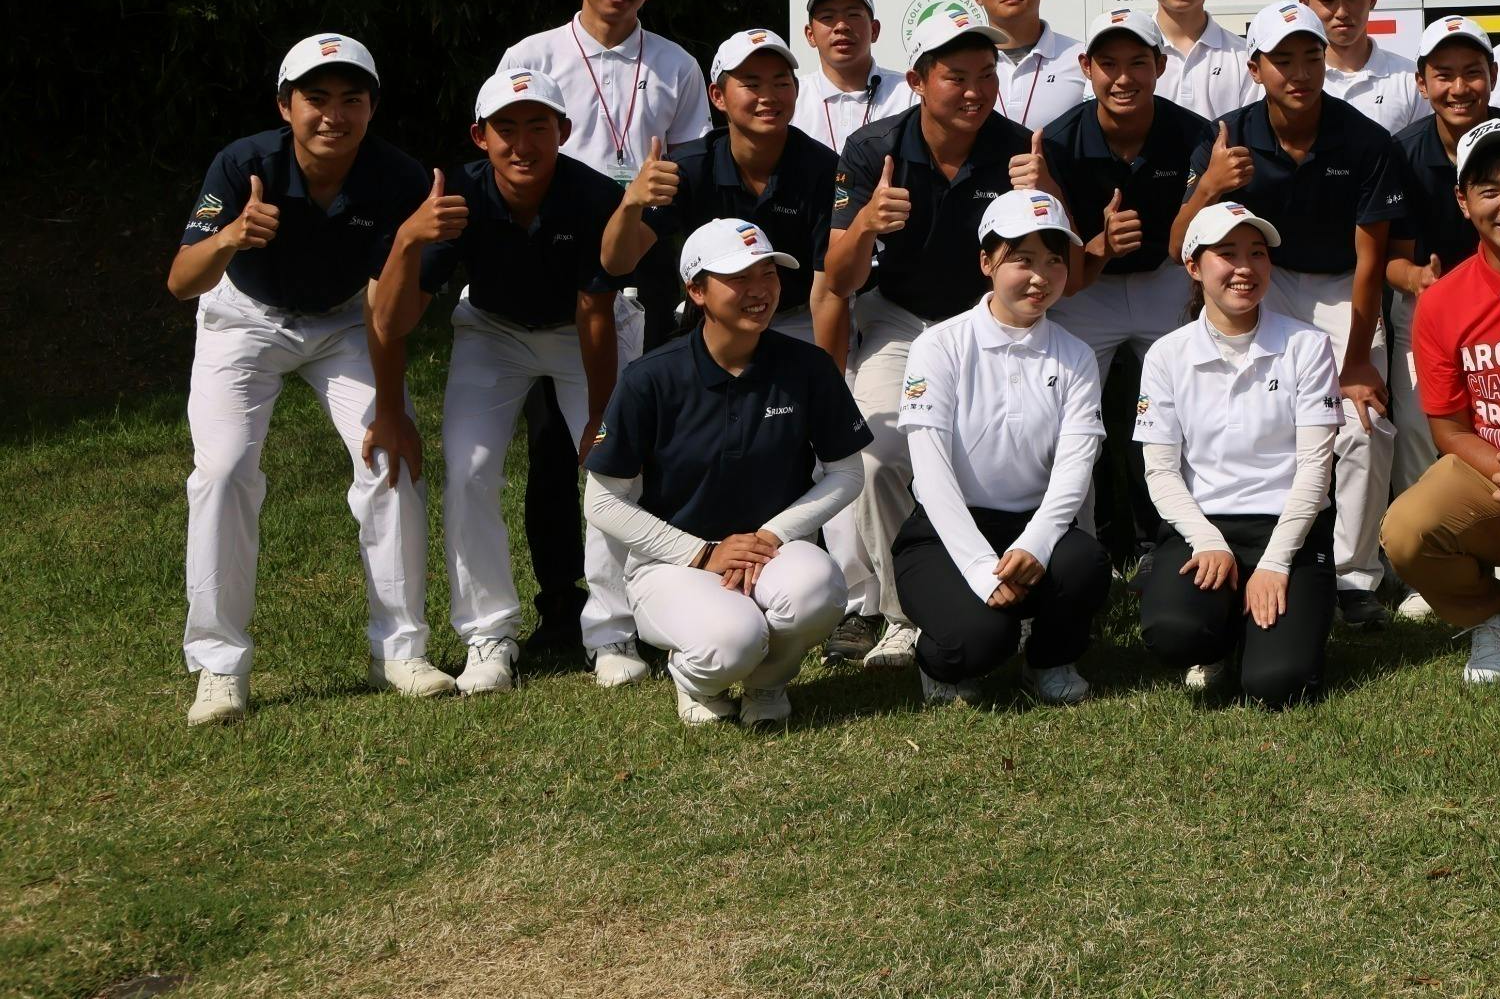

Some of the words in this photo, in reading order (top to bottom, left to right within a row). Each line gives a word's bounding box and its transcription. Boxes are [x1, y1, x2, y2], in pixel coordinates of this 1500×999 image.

[908, 2, 923, 25] GOLF
[1325, 166, 1350, 177] SRIXON
[764, 405, 794, 419] SRIXON
